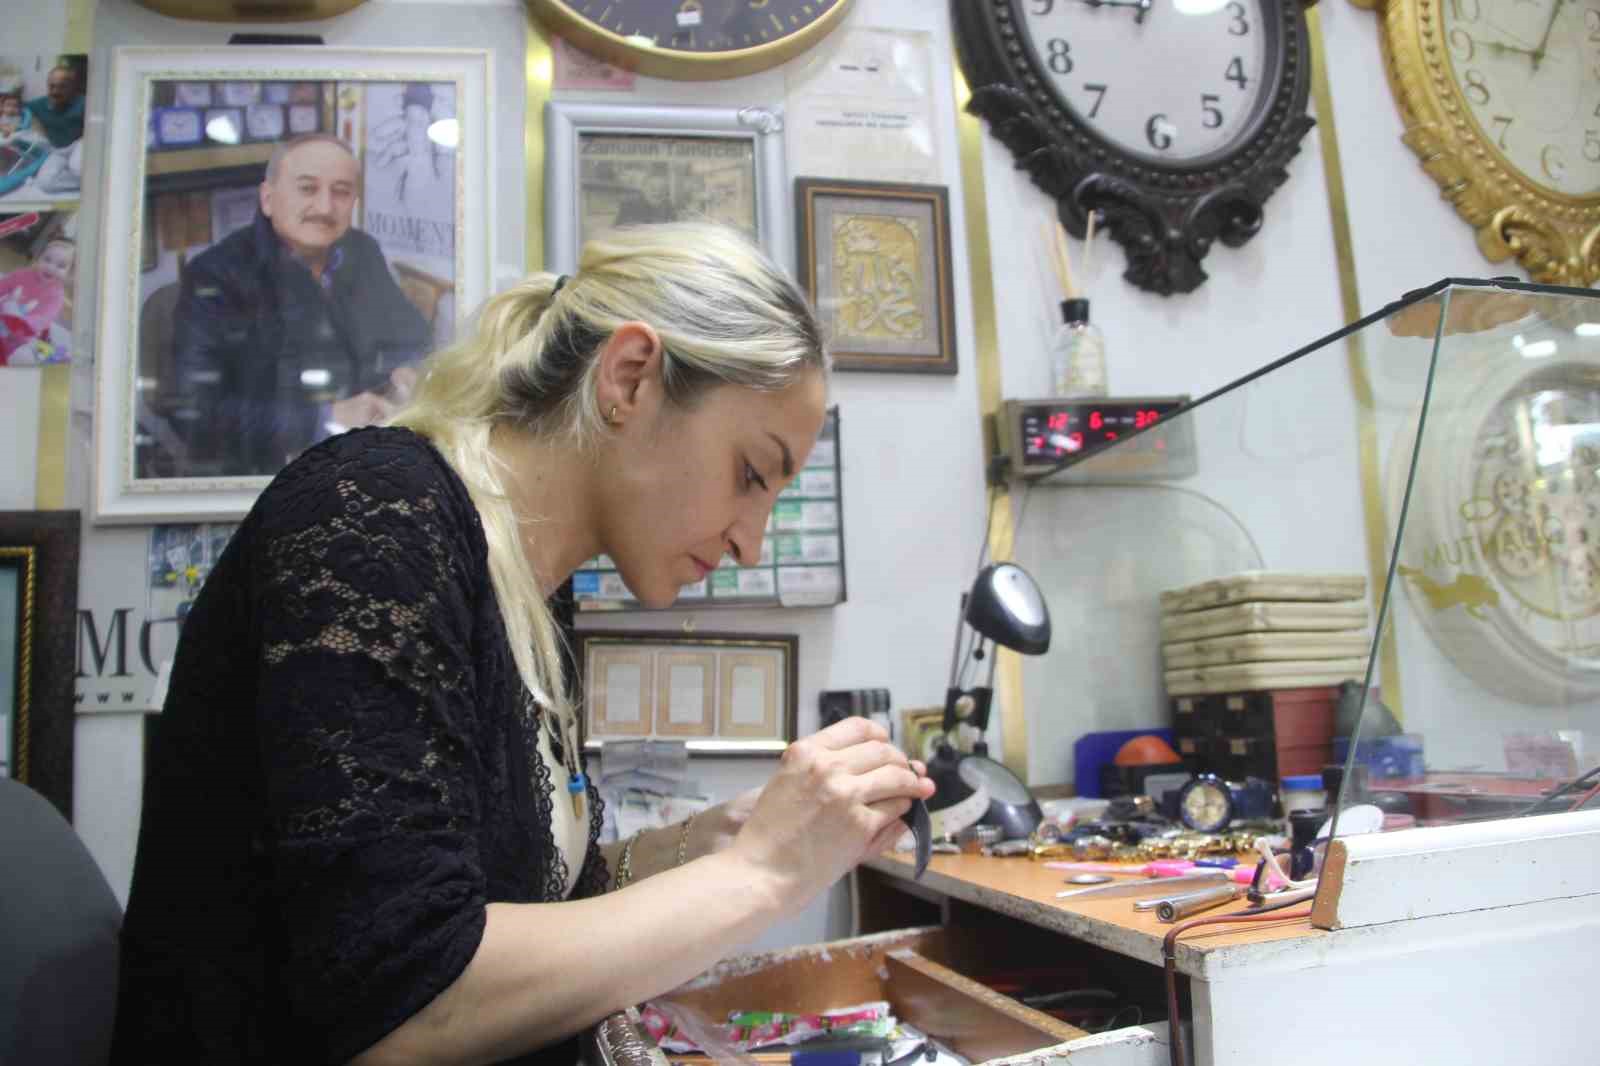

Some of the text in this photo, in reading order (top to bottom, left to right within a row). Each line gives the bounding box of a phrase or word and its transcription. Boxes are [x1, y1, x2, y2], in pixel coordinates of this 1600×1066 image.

[1226, 1, 1249, 36] 3
[1047, 38, 1073, 74] 8
[1224, 56, 1248, 90] 4
[1083, 83, 1108, 118] 7
[1465, 69, 1490, 105] 8
[1201, 94, 1223, 129] 5
[1146, 113, 1172, 150] 6
[1493, 115, 1513, 150] 7
[1540, 144, 1565, 180] 6
[1088, 410, 1104, 431] 6
